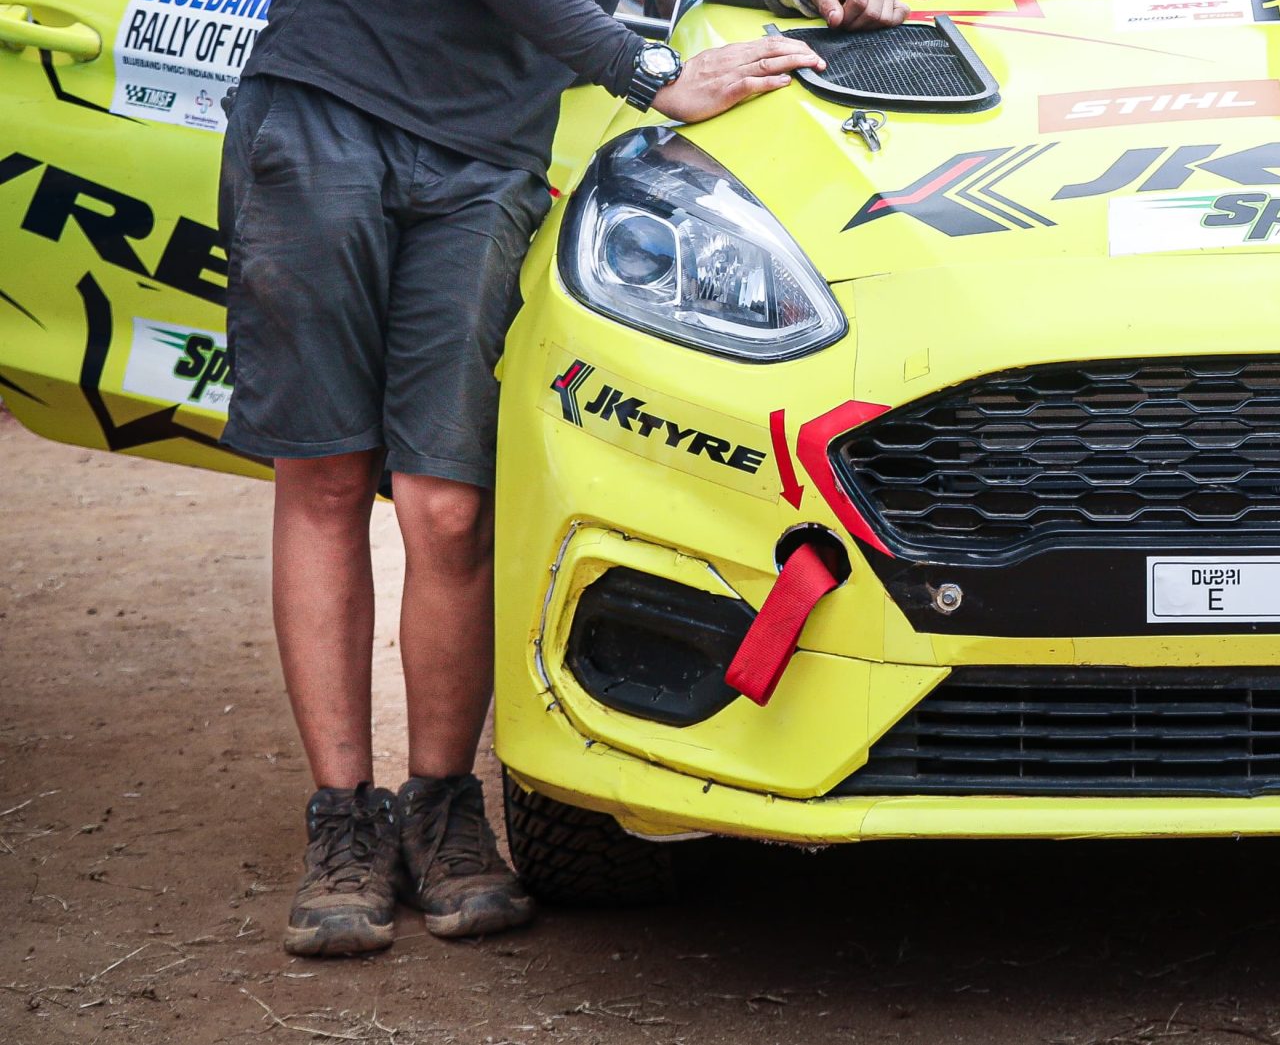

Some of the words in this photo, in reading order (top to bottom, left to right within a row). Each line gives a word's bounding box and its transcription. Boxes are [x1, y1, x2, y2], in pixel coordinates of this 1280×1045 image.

[124, 9, 200, 59] RALLY
[196, 20, 233, 64] OF
[1064, 89, 1258, 120] STIHL
[1208, 588, 1225, 611] E
